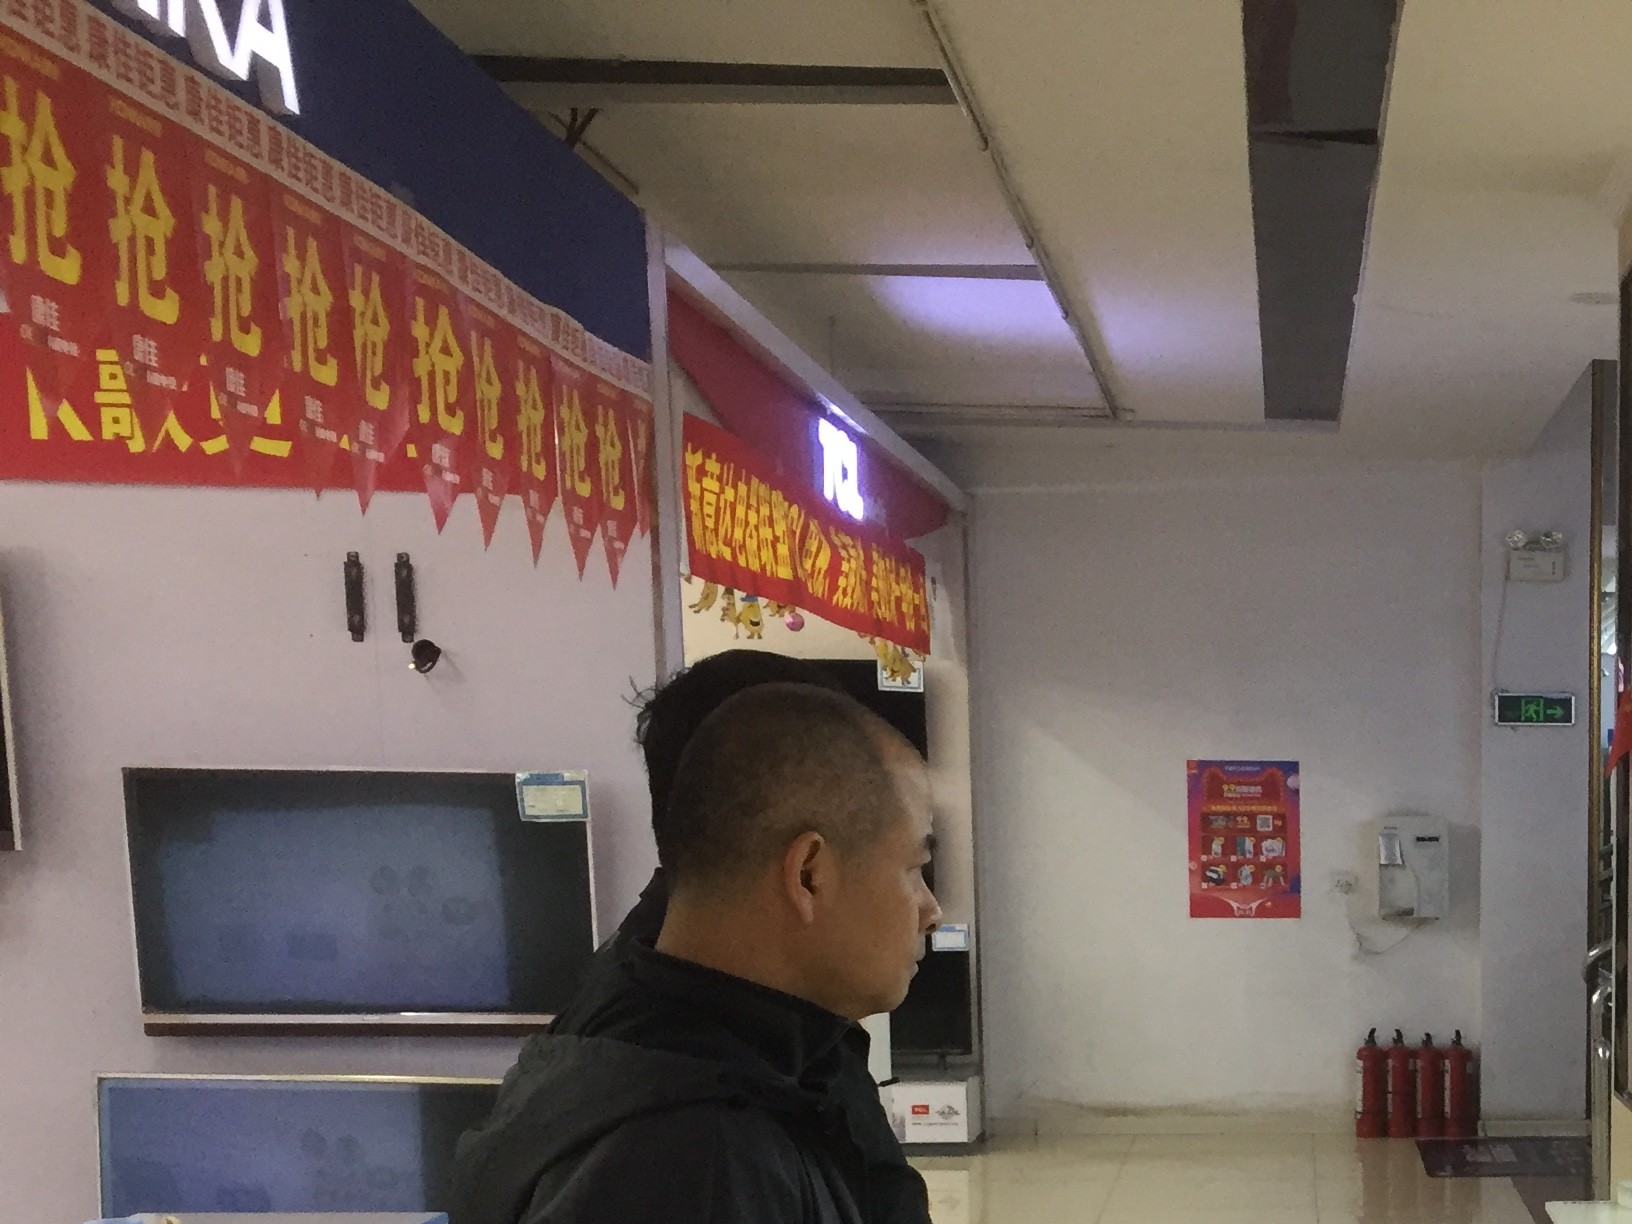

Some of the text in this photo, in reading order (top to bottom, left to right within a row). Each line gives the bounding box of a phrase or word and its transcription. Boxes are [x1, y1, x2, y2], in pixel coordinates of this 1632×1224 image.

[0, 75, 82, 285] 抢
[106, 134, 180, 325] 抢
[203, 183, 262, 357] 抢
[283, 225, 338, 387] 抢
[349, 262, 391, 411] 抢
[411, 296, 464, 436] 抢
[515, 358, 547, 481] 抢
[559, 384, 591, 498] 抢
[595, 404, 626, 511] 抢
